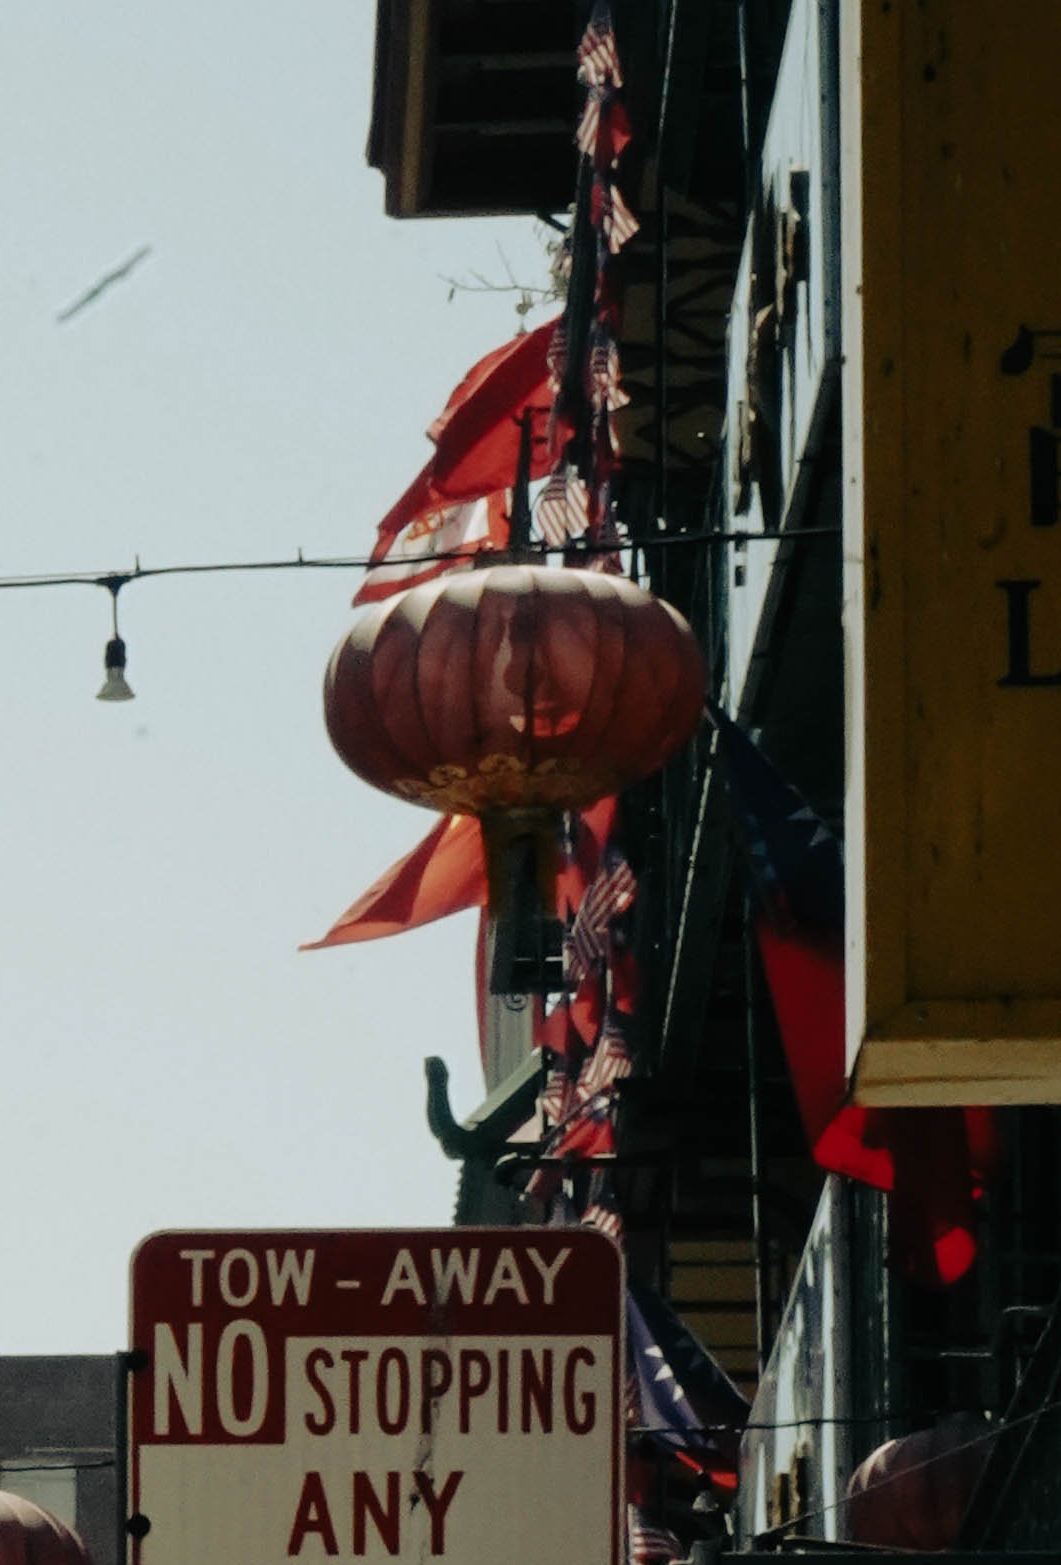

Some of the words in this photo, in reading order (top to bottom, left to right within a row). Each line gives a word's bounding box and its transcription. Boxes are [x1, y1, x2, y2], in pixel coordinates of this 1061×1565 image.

[180, 1249, 316, 1307] TOW
[381, 1247, 573, 1305] AWAY
[153, 1319, 270, 1438] NO
[304, 1346, 597, 1437] STOPPING
[287, 1471, 465, 1556] ANY
